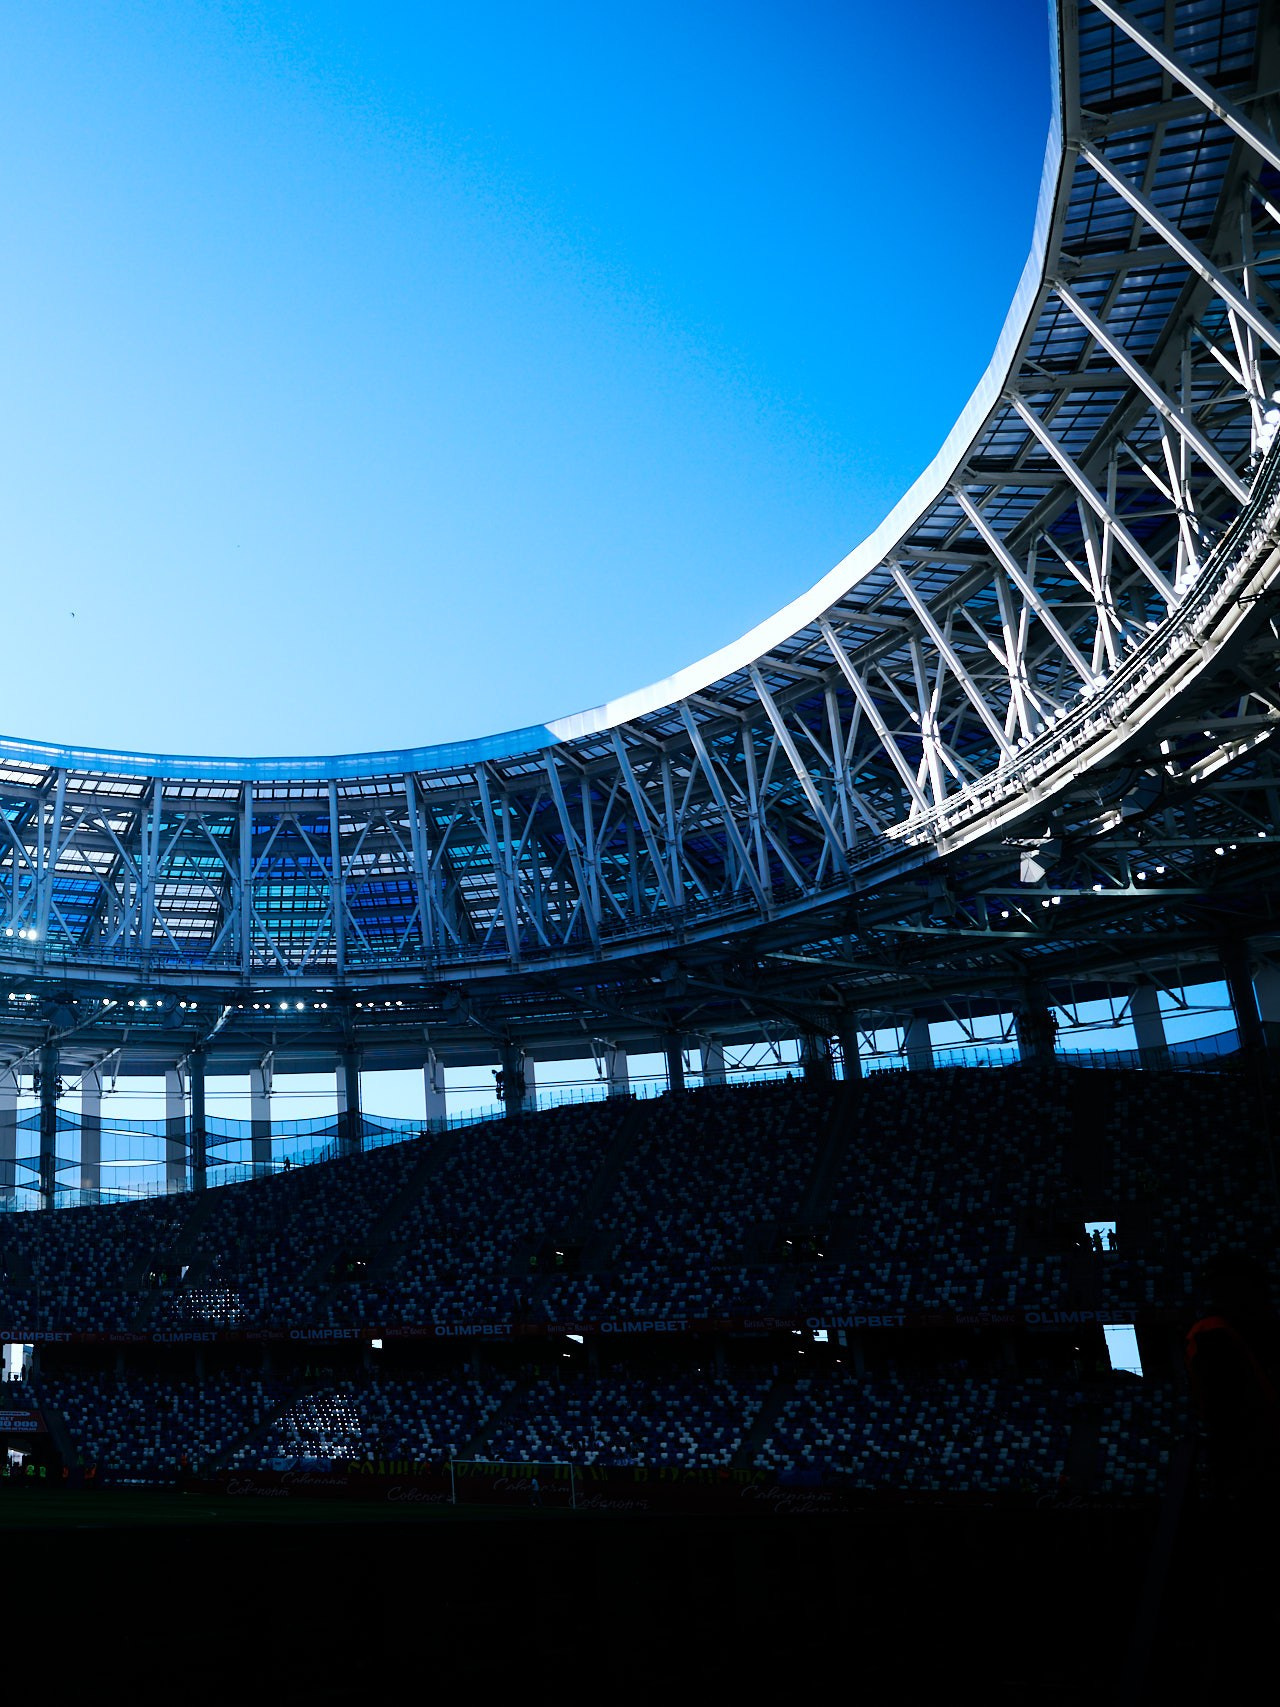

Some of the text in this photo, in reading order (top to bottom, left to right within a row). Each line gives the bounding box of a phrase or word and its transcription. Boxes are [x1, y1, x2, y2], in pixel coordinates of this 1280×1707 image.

[806, 1315, 907, 1328] OLIMPBET
[1025, 1309, 1139, 1324] OLIMPBET
[435, 1324, 513, 1336] OLIMPBET
[600, 1320, 688, 1333] OLIMPBET
[0, 1331, 72, 1342] OLIMPBET
[152, 1332, 217, 1343] OLIMPBET
[290, 1328, 361, 1340] OLIMPBET
